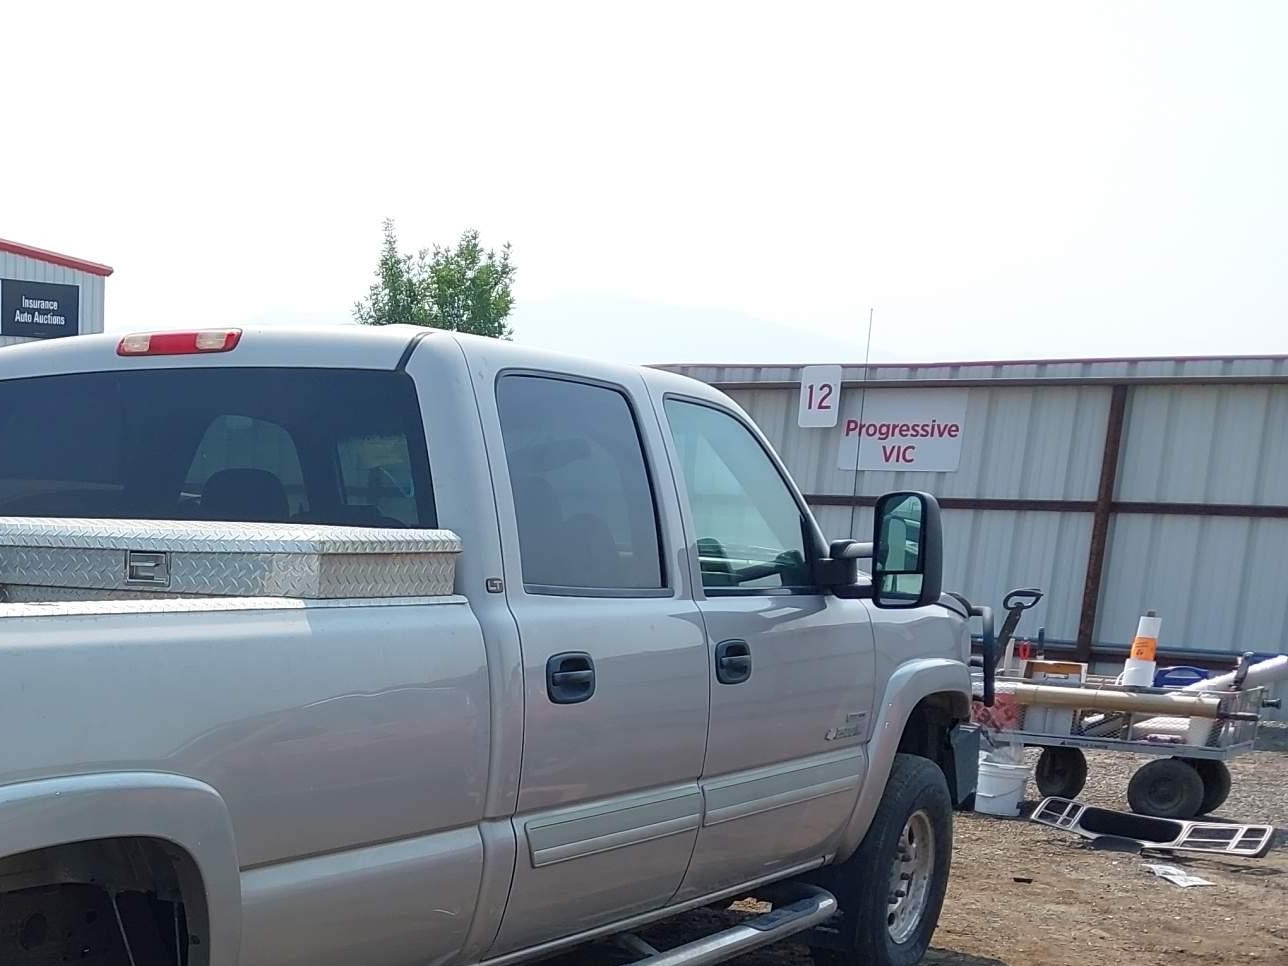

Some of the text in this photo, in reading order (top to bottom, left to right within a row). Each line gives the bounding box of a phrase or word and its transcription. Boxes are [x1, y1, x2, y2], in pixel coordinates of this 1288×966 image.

[22, 295, 58, 310] Insurance
[15, 310, 65, 326] Auto Auctions
[807, 383, 833, 411] 12
[845, 418, 960, 441] Progressive
[882, 444, 916, 464] VIC
